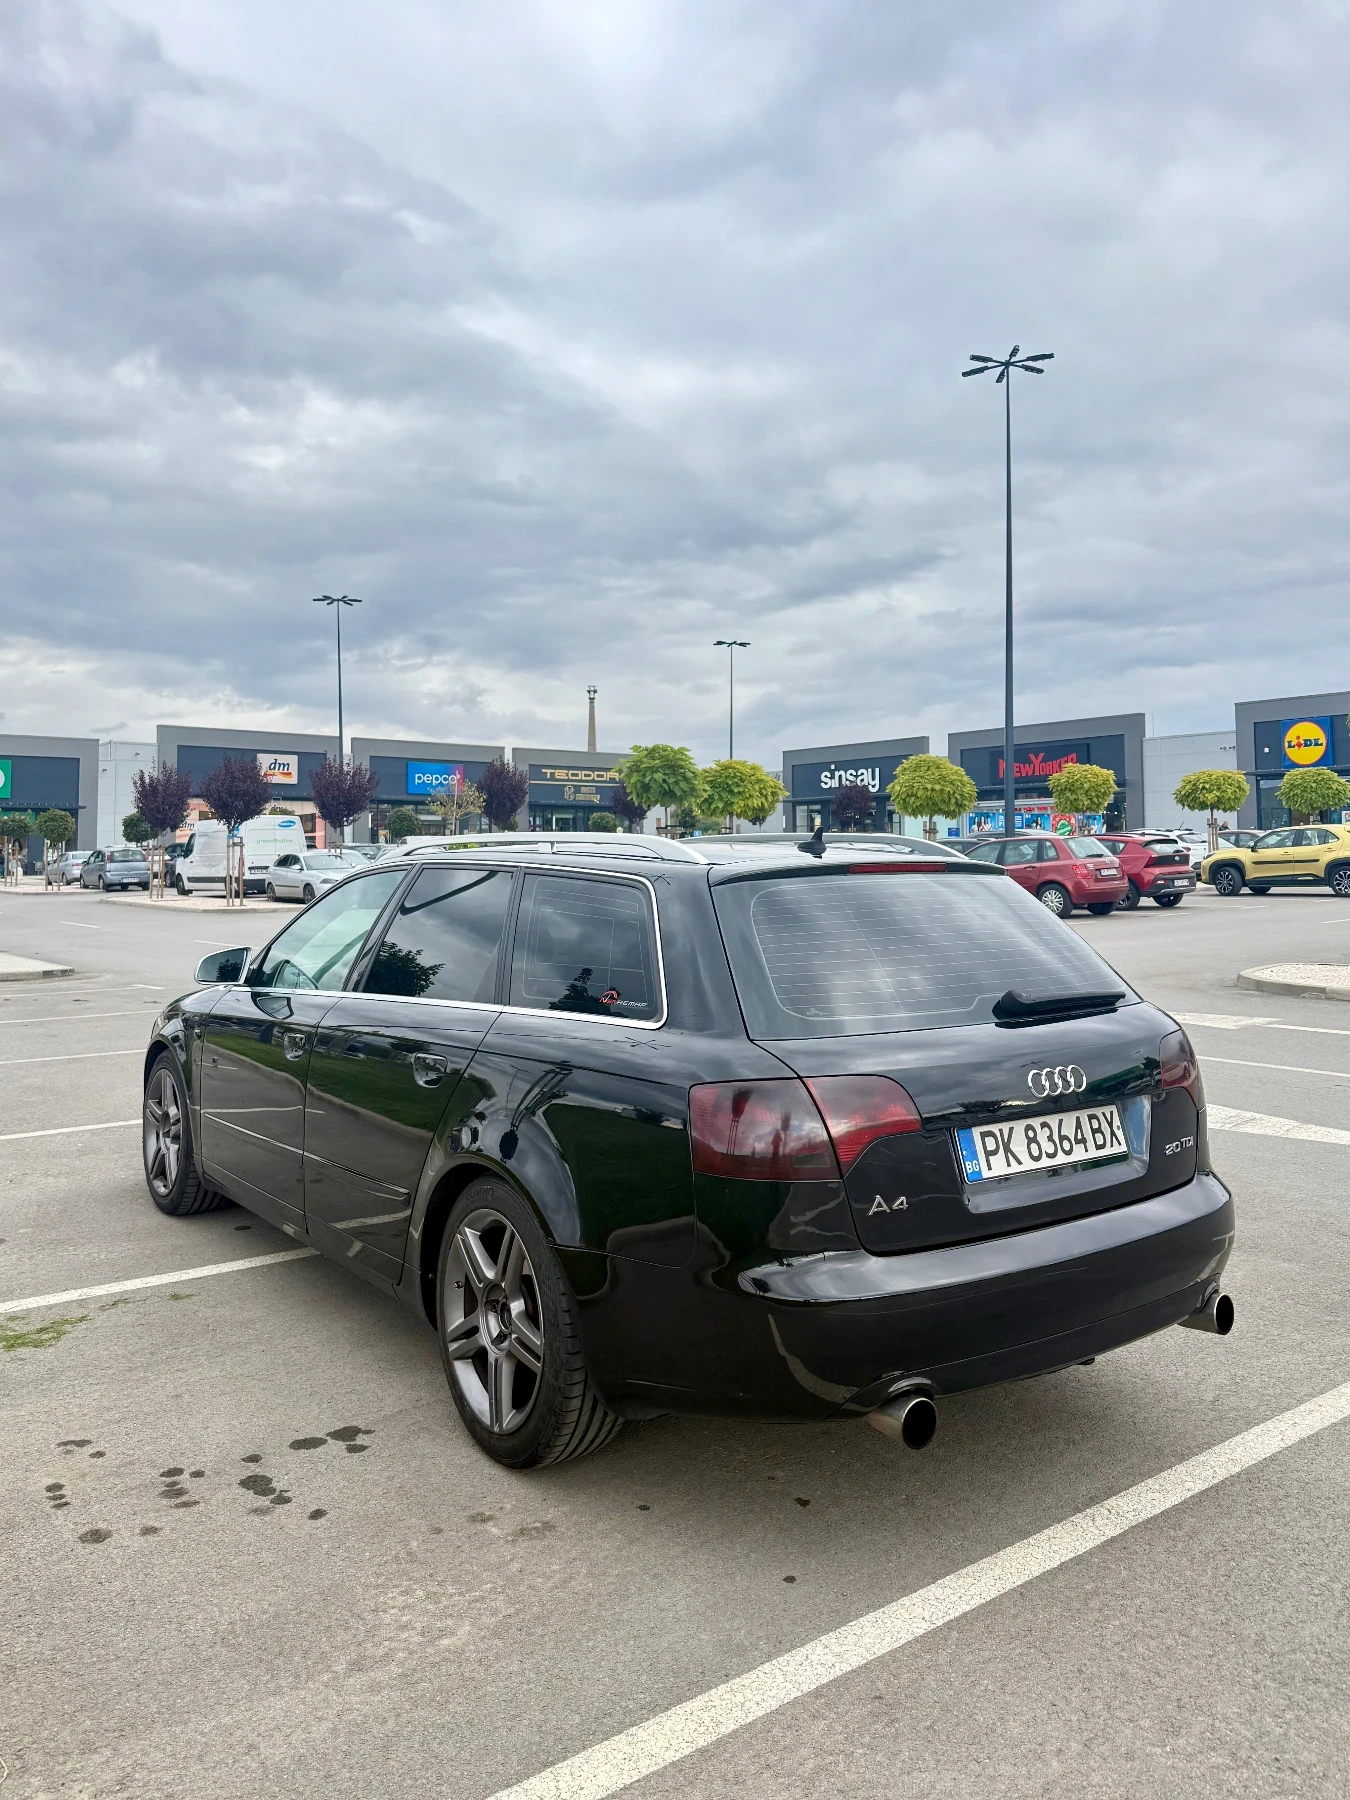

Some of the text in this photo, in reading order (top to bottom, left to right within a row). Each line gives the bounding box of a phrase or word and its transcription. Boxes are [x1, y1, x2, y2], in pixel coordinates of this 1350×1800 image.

[268, 758, 290, 771] dm
[415, 773, 457, 786] pepco
[542, 769, 620, 781] TEODOR
[820, 764, 880, 793] sinsay
[965, 1160, 980, 1174] BG
[867, 1195, 909, 1216] A4
